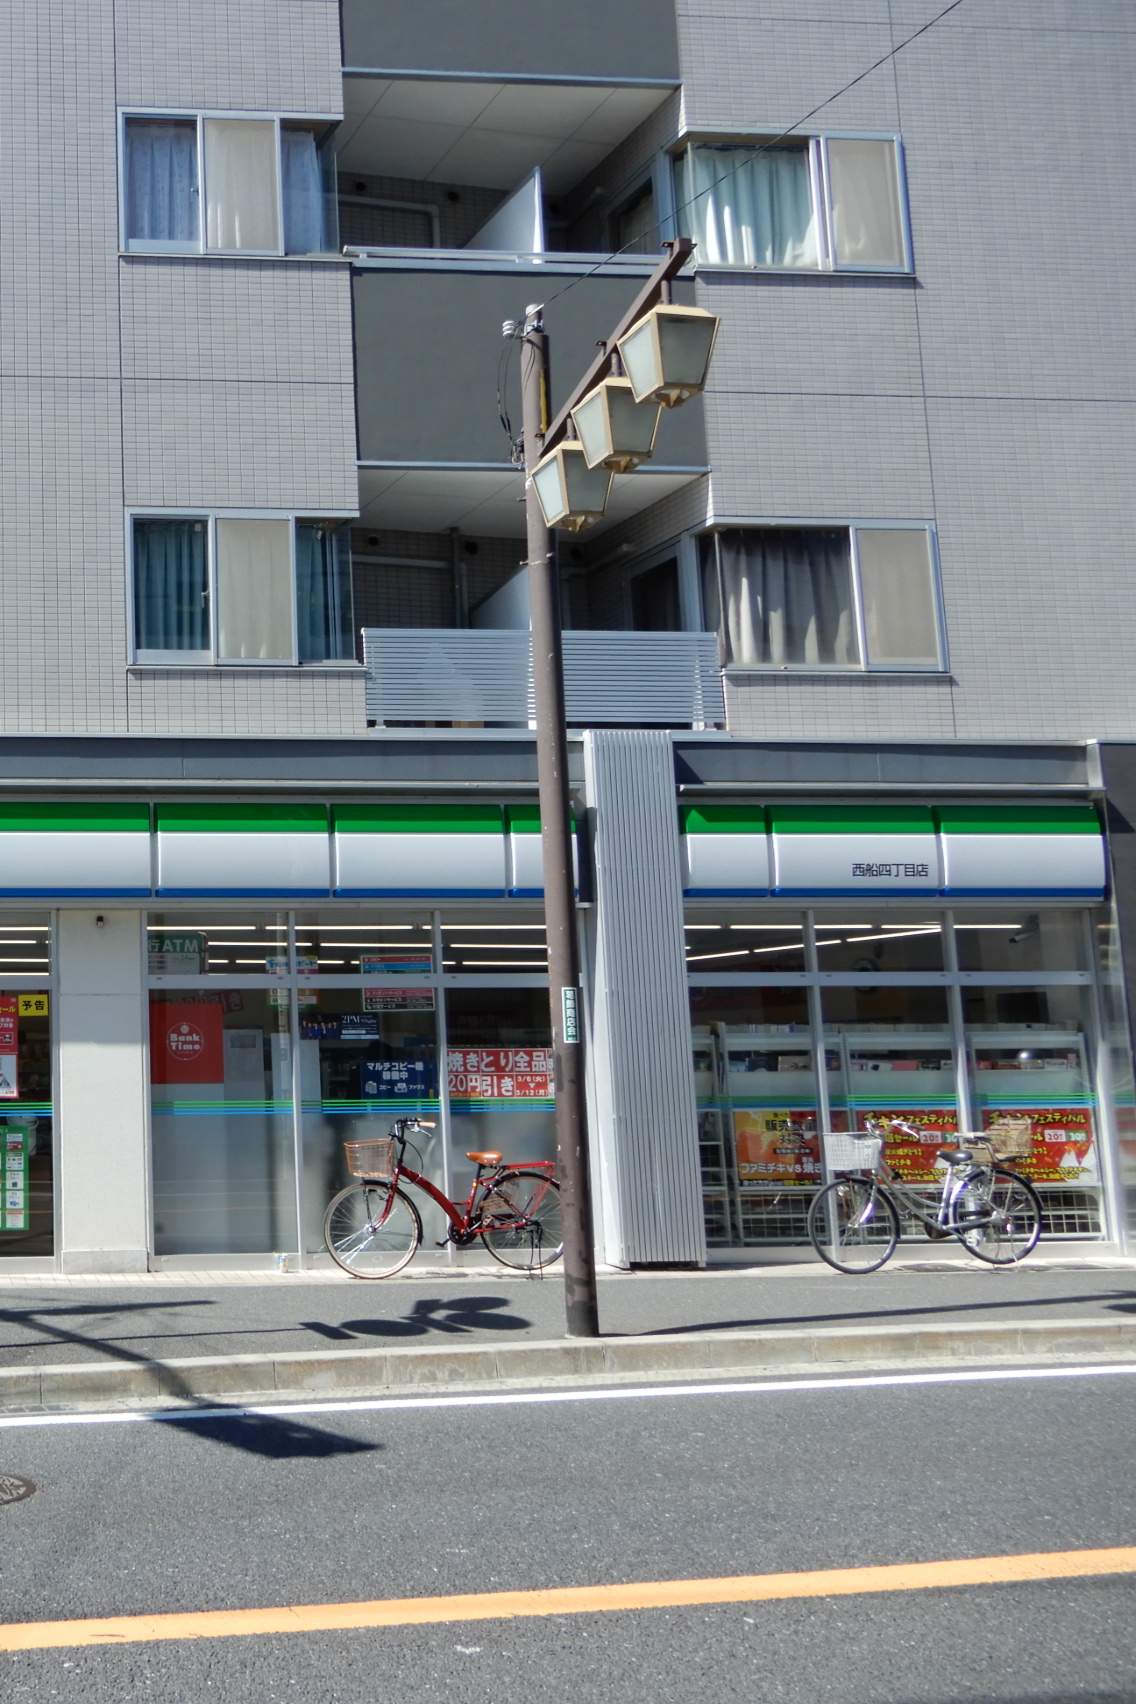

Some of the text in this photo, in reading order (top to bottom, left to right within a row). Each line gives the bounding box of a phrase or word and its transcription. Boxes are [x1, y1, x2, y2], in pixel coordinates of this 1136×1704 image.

[851, 863, 929, 877] 西船四丁目店
[22, 1000, 45, 1011] 予告
[169, 1033, 200, 1041] Bank
[170, 1042, 201, 1050] Time
[447, 1052, 547, 1072] 焼きとり全品
[448, 1075, 514, 1097] 20円引き
